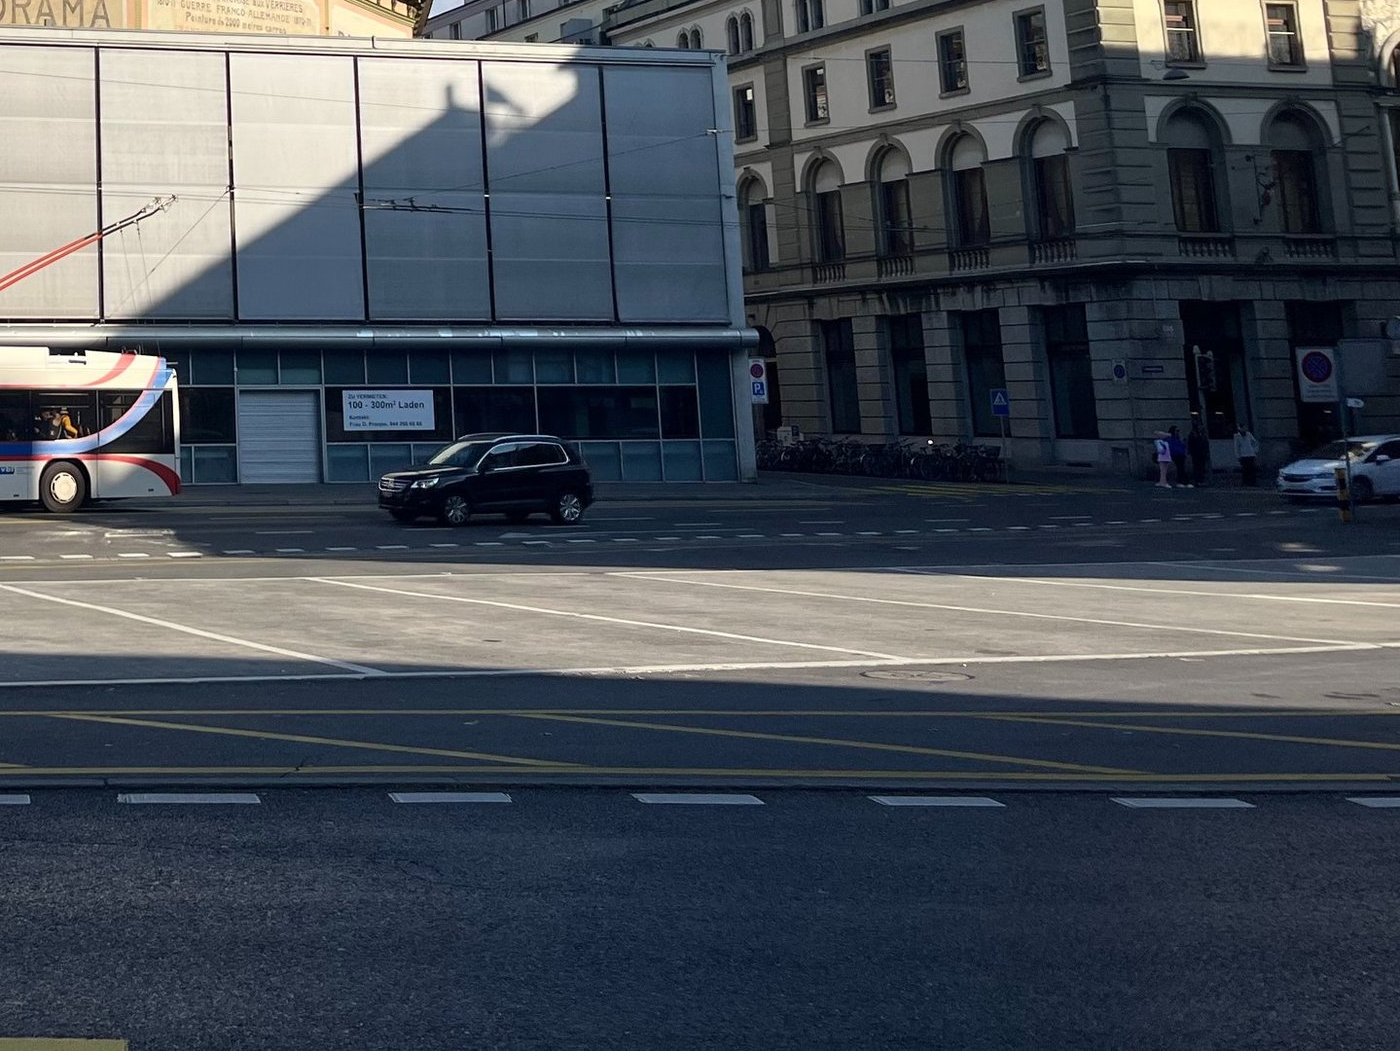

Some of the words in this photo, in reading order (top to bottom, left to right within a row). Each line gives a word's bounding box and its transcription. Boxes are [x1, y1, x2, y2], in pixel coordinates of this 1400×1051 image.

[181, 0, 212, 13] GUERRE
[348, 401, 363, 409] 100
[398, 400, 425, 409] Laden
